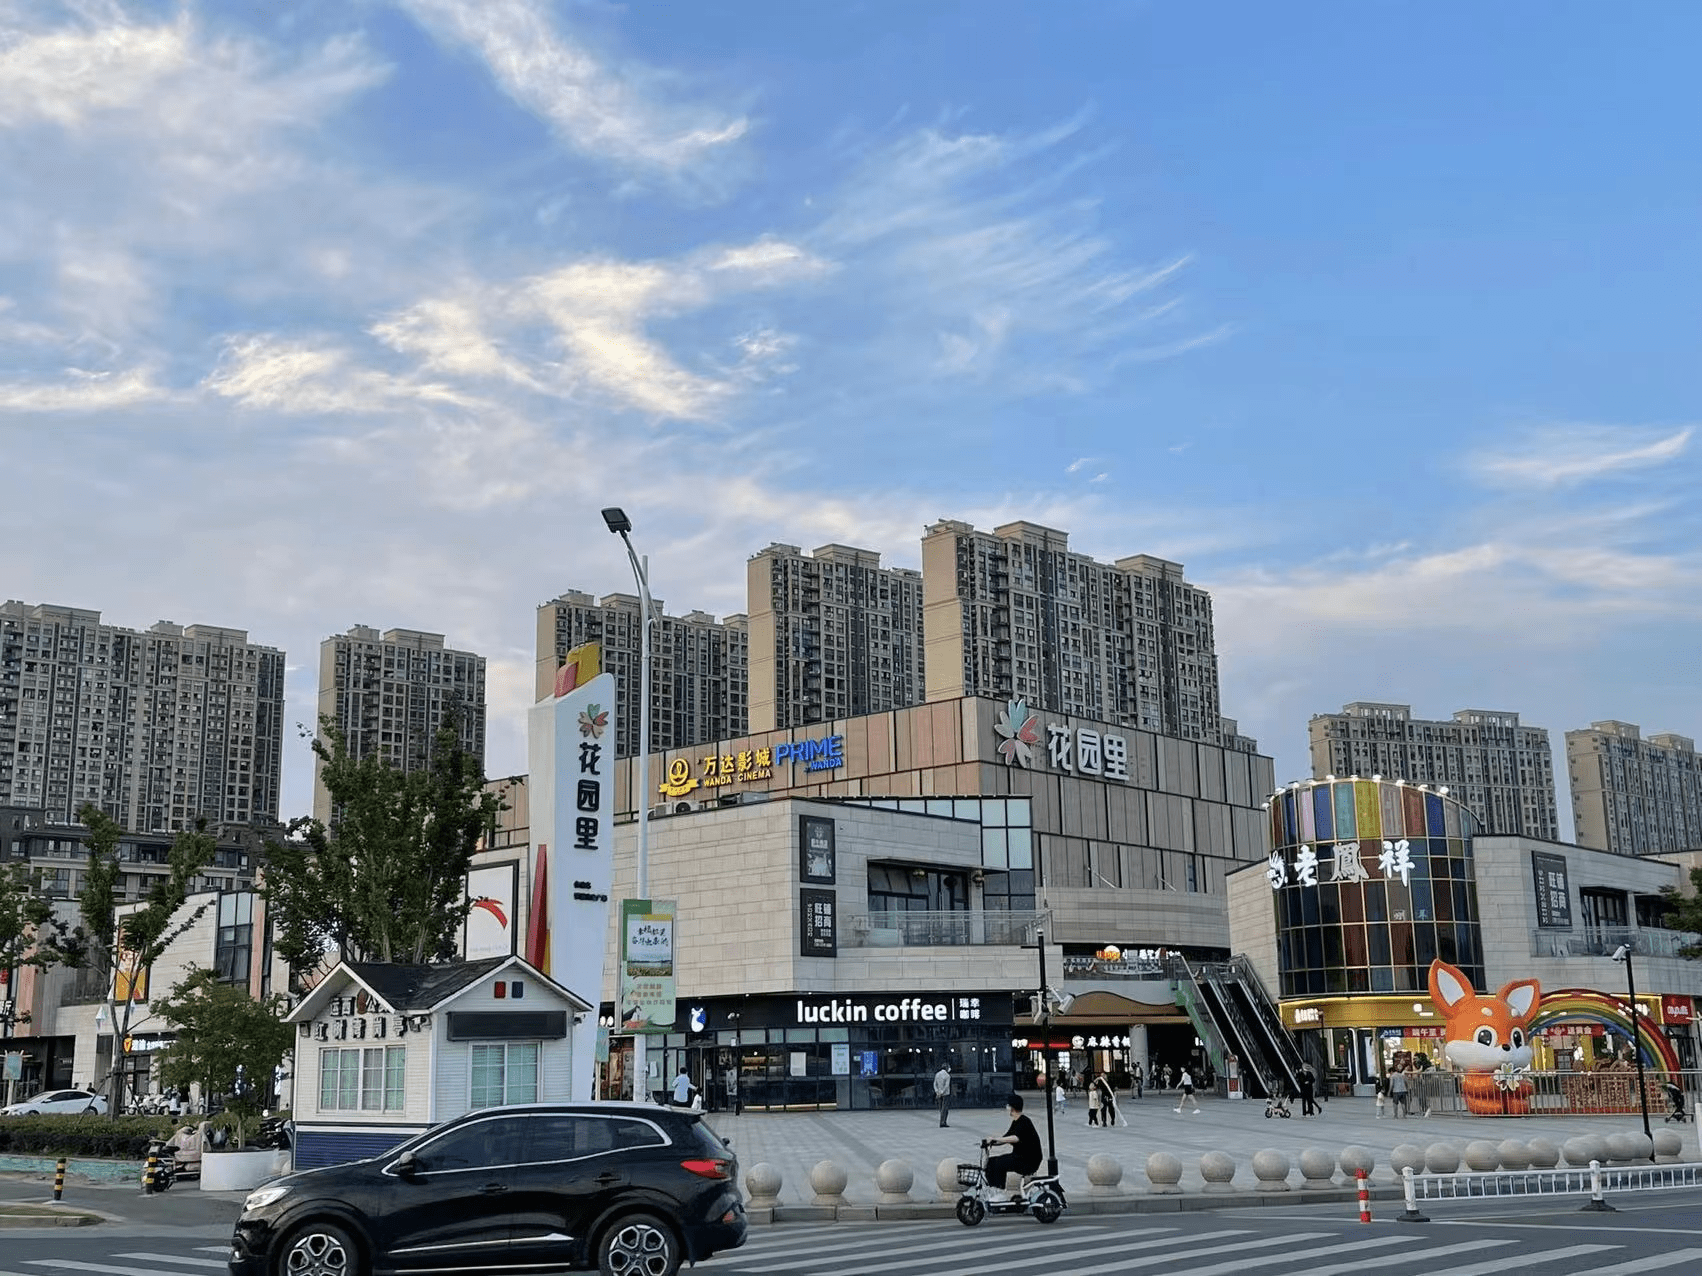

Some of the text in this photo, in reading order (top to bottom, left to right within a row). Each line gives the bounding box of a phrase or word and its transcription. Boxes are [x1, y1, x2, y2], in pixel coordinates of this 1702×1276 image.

[703, 747, 772, 776] 万达影城
[775, 735, 843, 766] PRIME
[810, 756, 842, 771] WANDA
[1047, 722, 1130, 782] 花园里
[704, 769, 772, 787] WANDA CINEMA
[573, 741, 602, 851] 花园里
[1294, 839, 1416, 887] 老鳳祥
[797, 998, 947, 1023] luckin coffee
[959, 997, 981, 1009] 瑞幸
[959, 1009, 981, 1020] 咖啡
